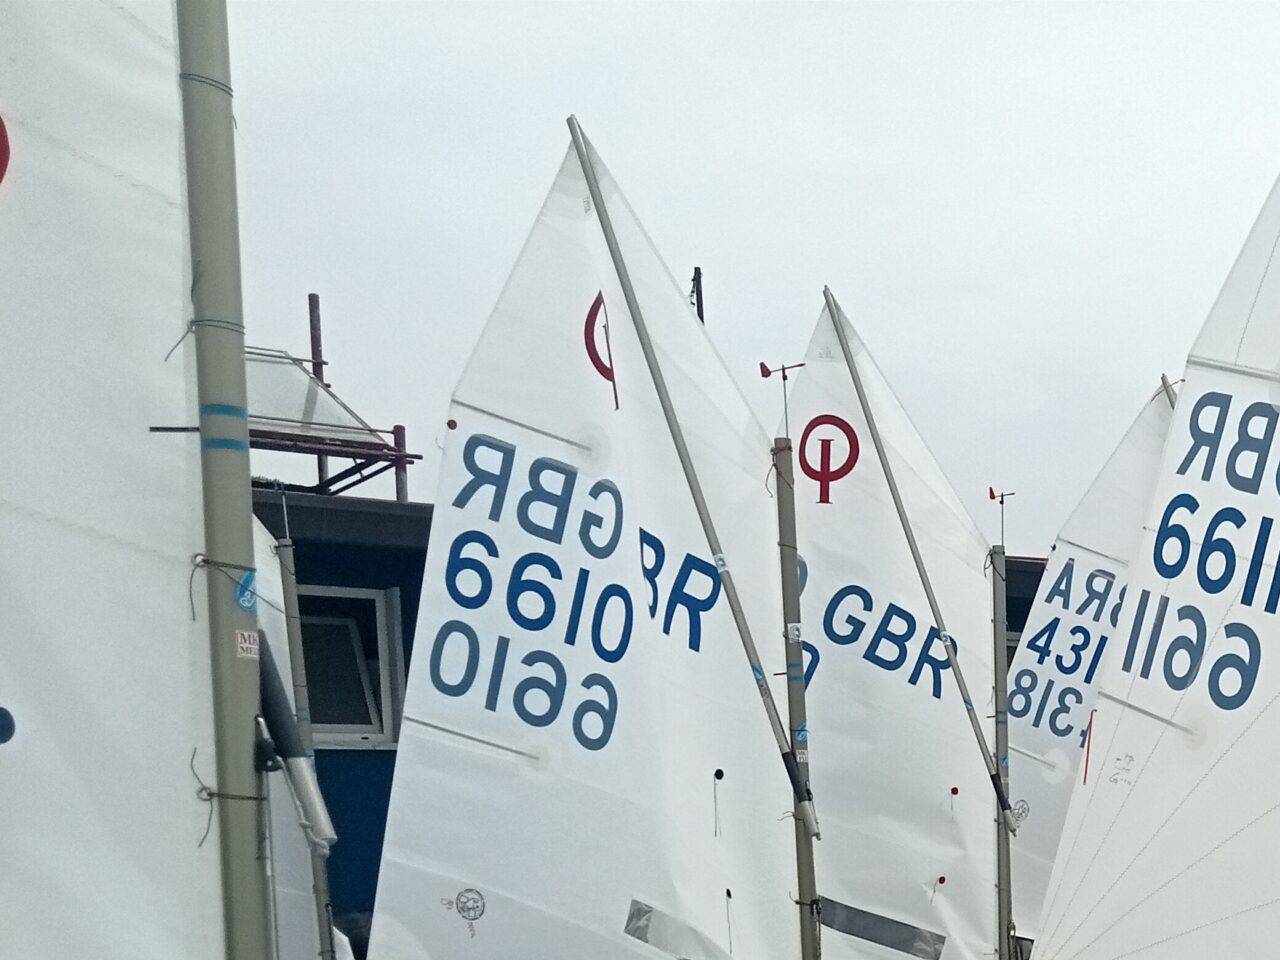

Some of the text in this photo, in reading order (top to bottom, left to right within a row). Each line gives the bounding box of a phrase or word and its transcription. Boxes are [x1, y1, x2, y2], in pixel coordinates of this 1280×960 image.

[445, 529, 634, 663] 6610
[822, 584, 958, 700] GBR
[1026, 616, 1109, 685] 431
